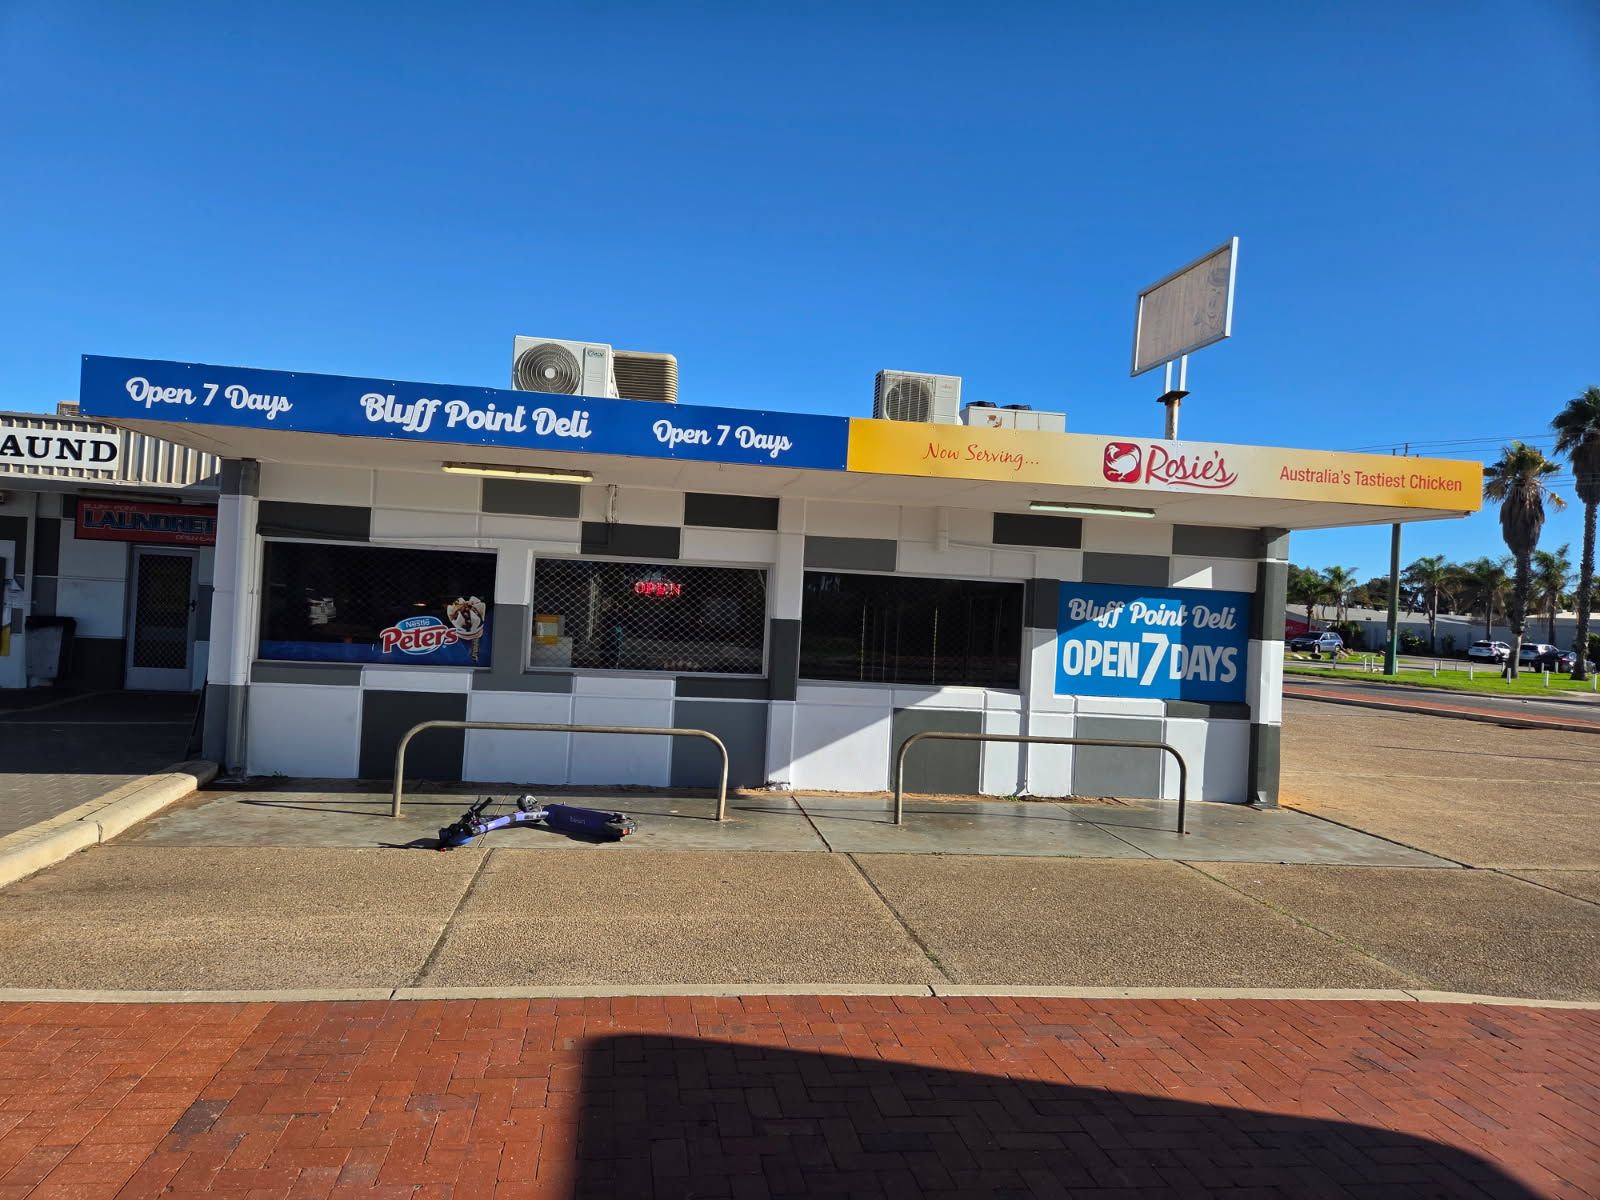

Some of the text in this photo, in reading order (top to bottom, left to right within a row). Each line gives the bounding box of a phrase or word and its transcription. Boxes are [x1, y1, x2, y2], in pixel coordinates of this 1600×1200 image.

[125, 376, 293, 420] Open 7 Days
[359, 392, 592, 439] Bluff Point Deli
[0, 434, 118, 463] AUND
[652, 418, 793, 458] Open 7 Days
[924, 442, 1040, 471] Now Serving...
[1145, 444, 1237, 487] Rosie's
[1279, 465, 1463, 492] Australia's Tastiest Chicken
[634, 581, 682, 597] OPEN
[1068, 598, 1237, 630] Bluff Point Deli
[379, 626, 459, 653] Peters
[1062, 632, 1238, 686] OPEN 7 DAYS
